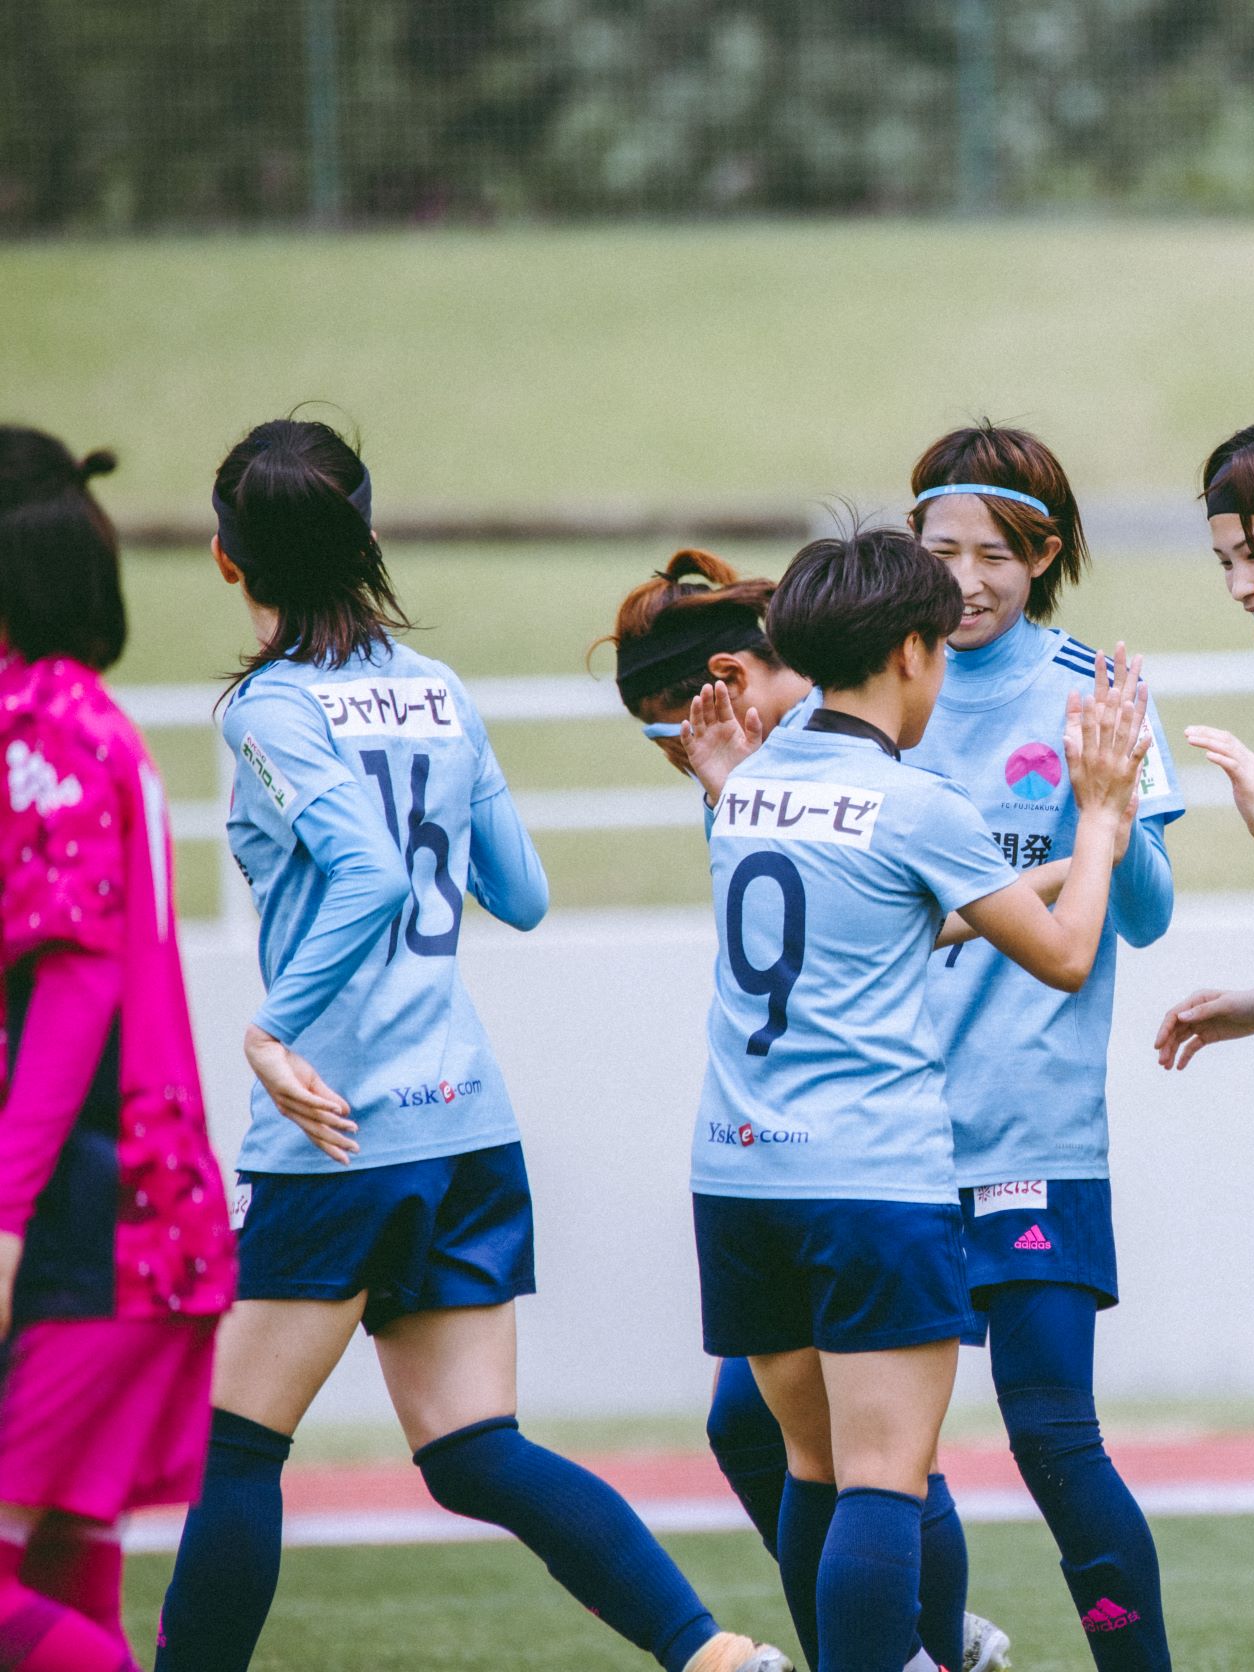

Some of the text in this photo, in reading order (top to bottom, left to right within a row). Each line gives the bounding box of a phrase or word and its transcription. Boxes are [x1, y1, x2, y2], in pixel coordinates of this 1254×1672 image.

[318, 688, 452, 727] シャトレーゼ
[713, 789, 879, 837] ャトレーゼ
[1014, 803, 1060, 812] FUJIZAKURA
[359, 750, 463, 967] 16
[726, 850, 806, 1057] 9
[1013, 1240, 1052, 1250] adidas
